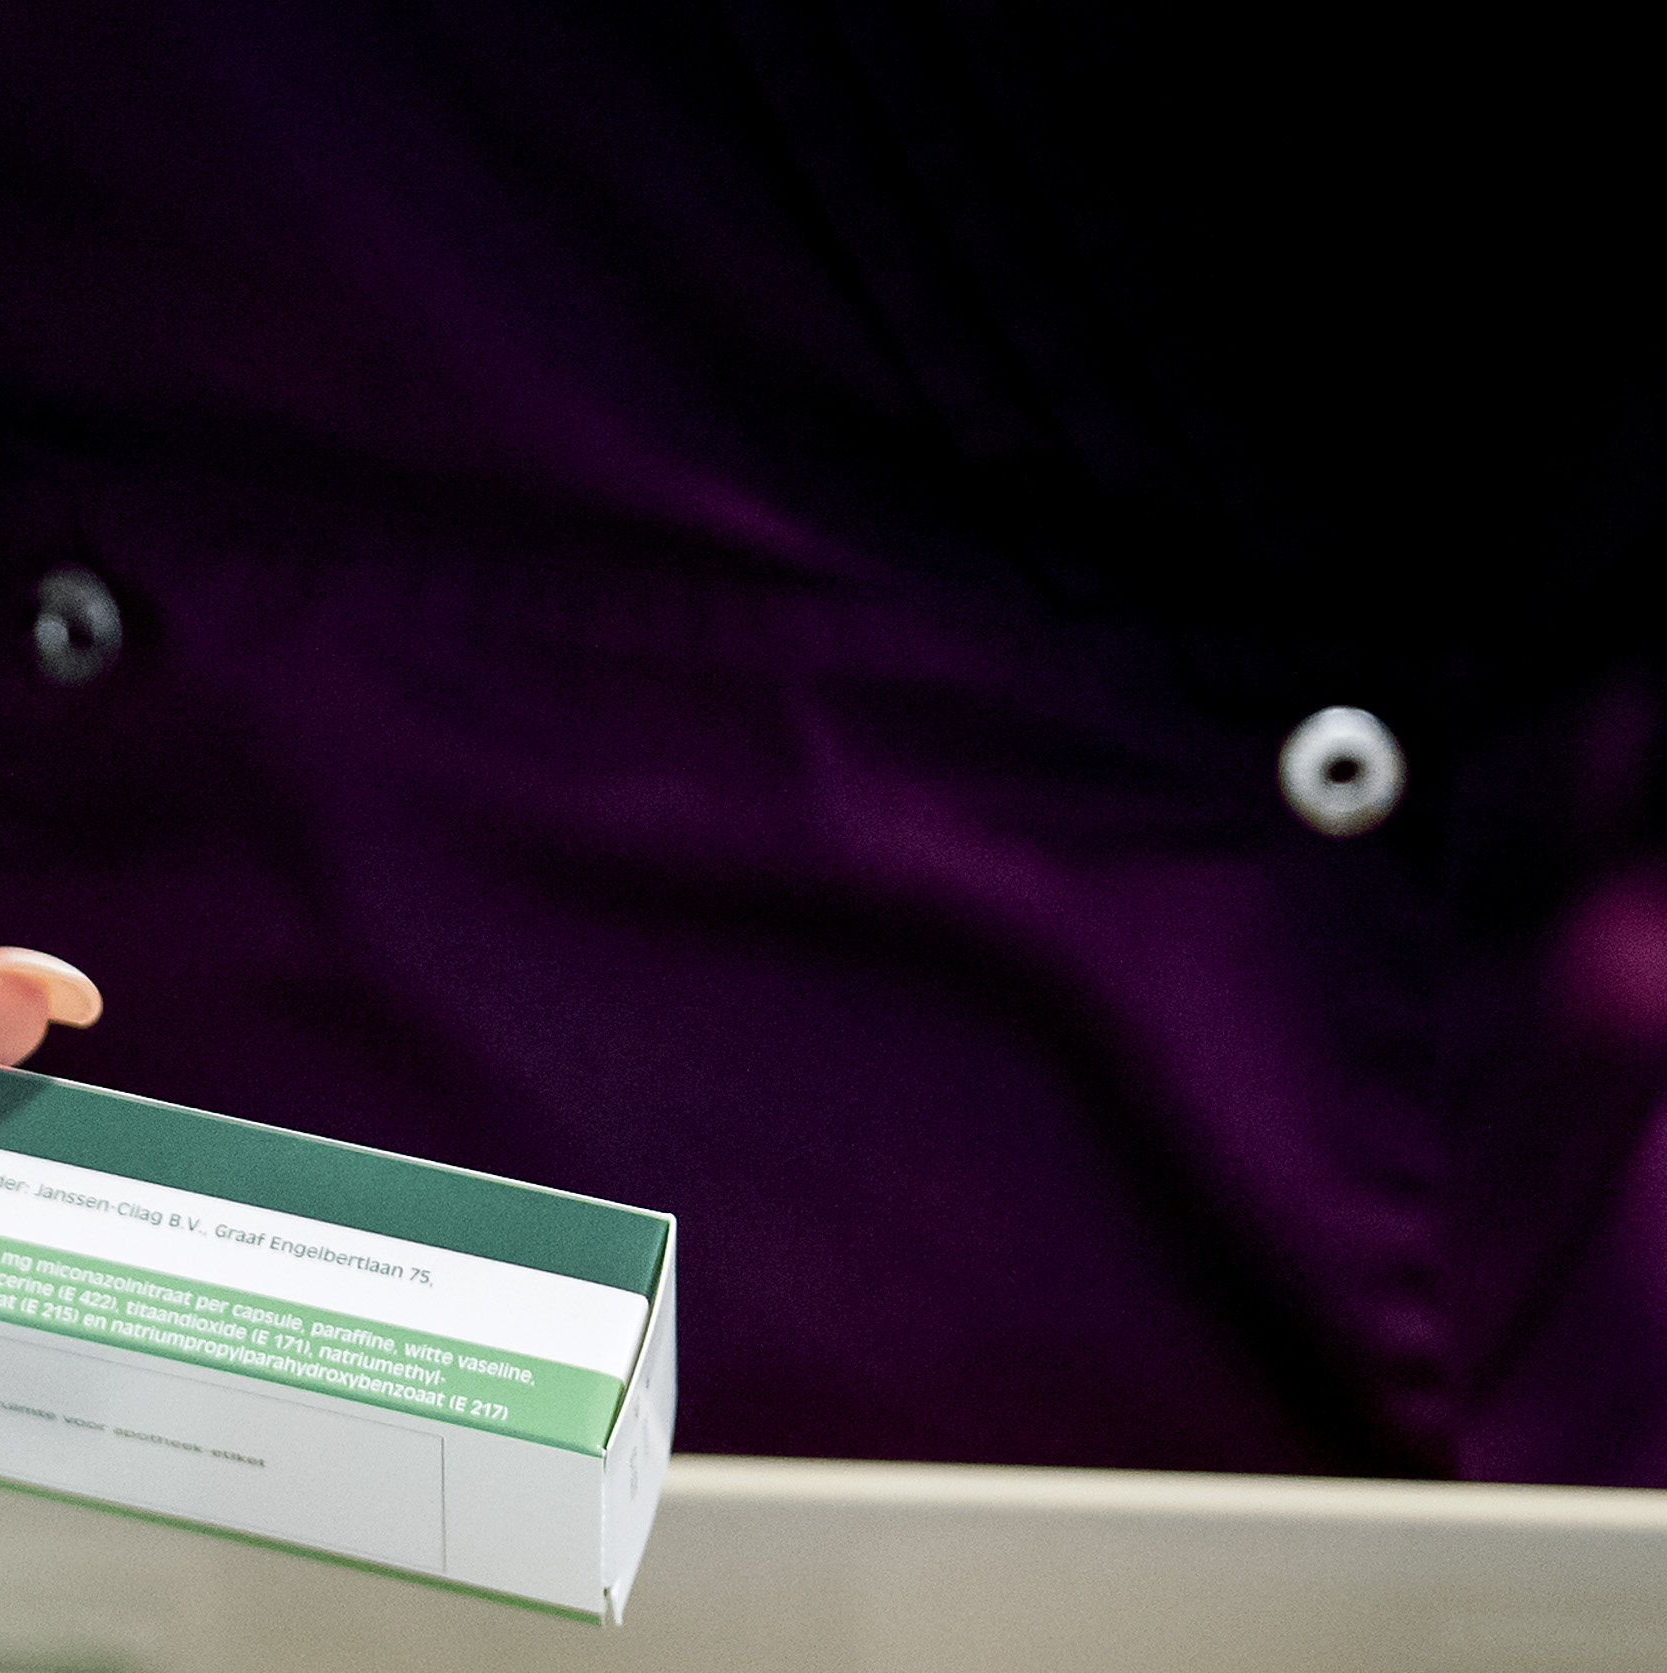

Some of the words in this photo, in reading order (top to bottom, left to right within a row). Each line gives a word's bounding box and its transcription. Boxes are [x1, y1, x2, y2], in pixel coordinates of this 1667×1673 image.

[34, 1181, 163, 1227] Janssen-Cilag
[215, 1222, 266, 1248] Graaf
[270, 1236, 404, 1279] Engelbertlaan
[410, 1266, 434, 1288] 75,
[1, 1250, 33, 1273] mg
[36, 1258, 191, 1307] miconazolnitraat
[195, 1294, 229, 1315] per
[232, 1301, 305, 1335] capsule,
[310, 1319, 398, 1356] paraffine,
[403, 1341, 454, 1366] witte
[457, 1354, 536, 1387] vaseline,
[82, 1314, 107, 1330] en
[470, 1399, 509, 1422] 217)
[126, 1299, 248, 1341] titaandioxide
[318, 1343, 447, 1385] natriumethyl-
